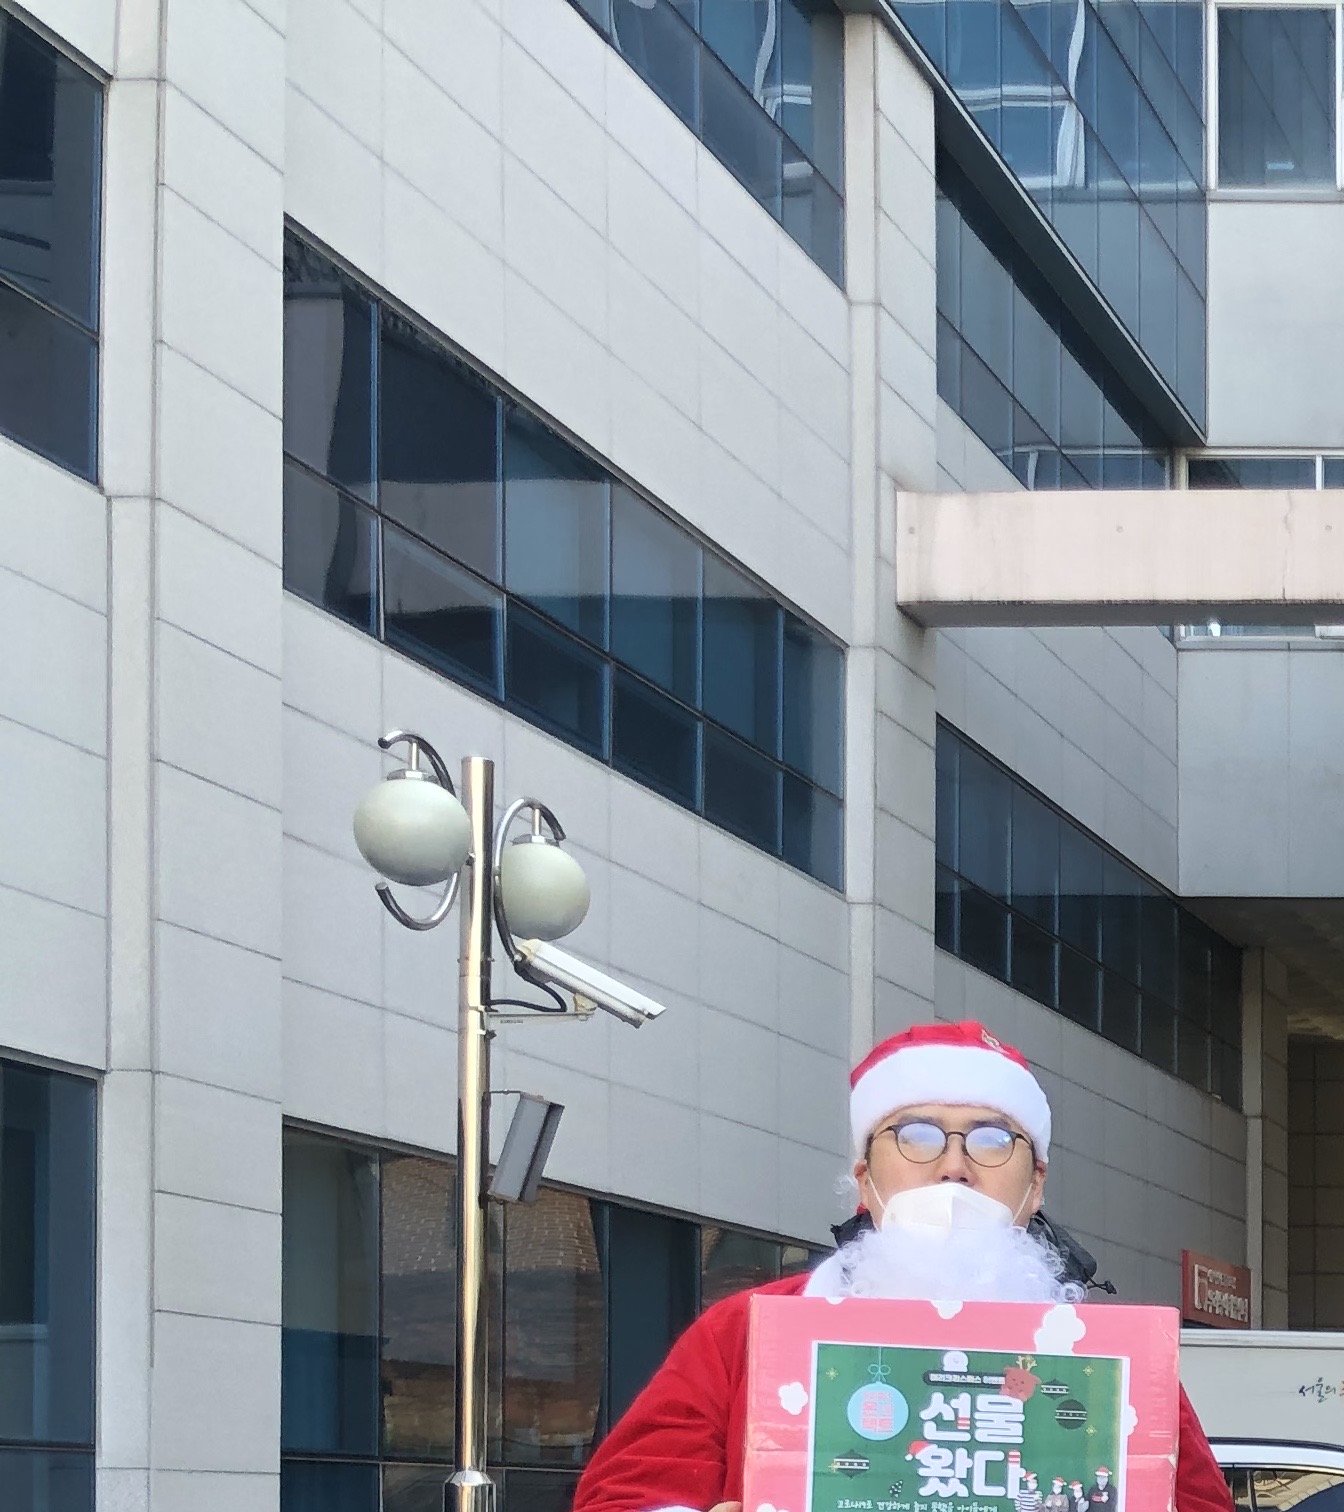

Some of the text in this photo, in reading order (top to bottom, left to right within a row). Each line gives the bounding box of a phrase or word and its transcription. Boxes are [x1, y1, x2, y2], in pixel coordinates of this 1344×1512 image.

[918, 1390, 1026, 1443] 선물
[1299, 1377, 1337, 1403] 서울의
[915, 1443, 1026, 1498] 왔다
